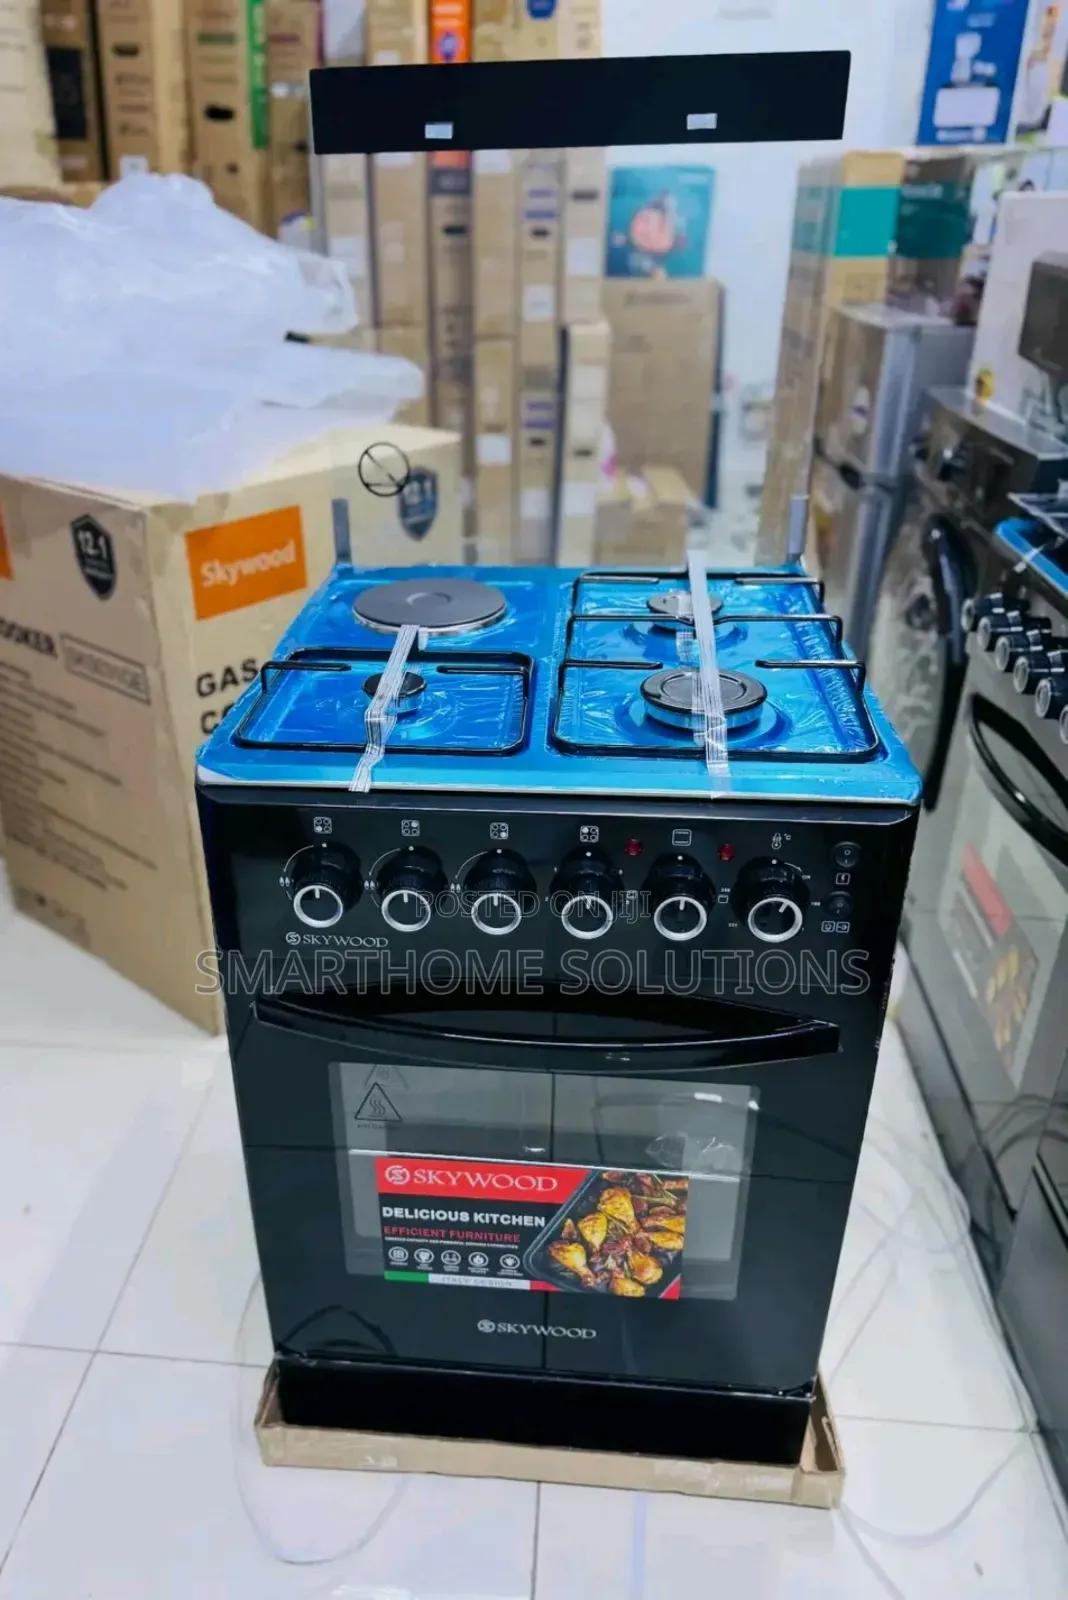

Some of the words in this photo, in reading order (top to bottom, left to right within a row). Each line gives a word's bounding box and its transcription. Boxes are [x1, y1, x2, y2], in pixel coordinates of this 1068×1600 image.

[202, 540, 296, 587] Skywood
[196, 657, 258, 698] GAS
[302, 933, 389, 948] SKYWOOD
[413, 1168, 558, 1192] SKYWOOD
[382, 1206, 470, 1222] DELICIOUS
[474, 1212, 546, 1228] KITCHEN
[383, 1225, 448, 1239] EFFICIENT
[449, 1229, 521, 1243] FURNITURE
[497, 1323, 597, 1339] SKYWOOD
